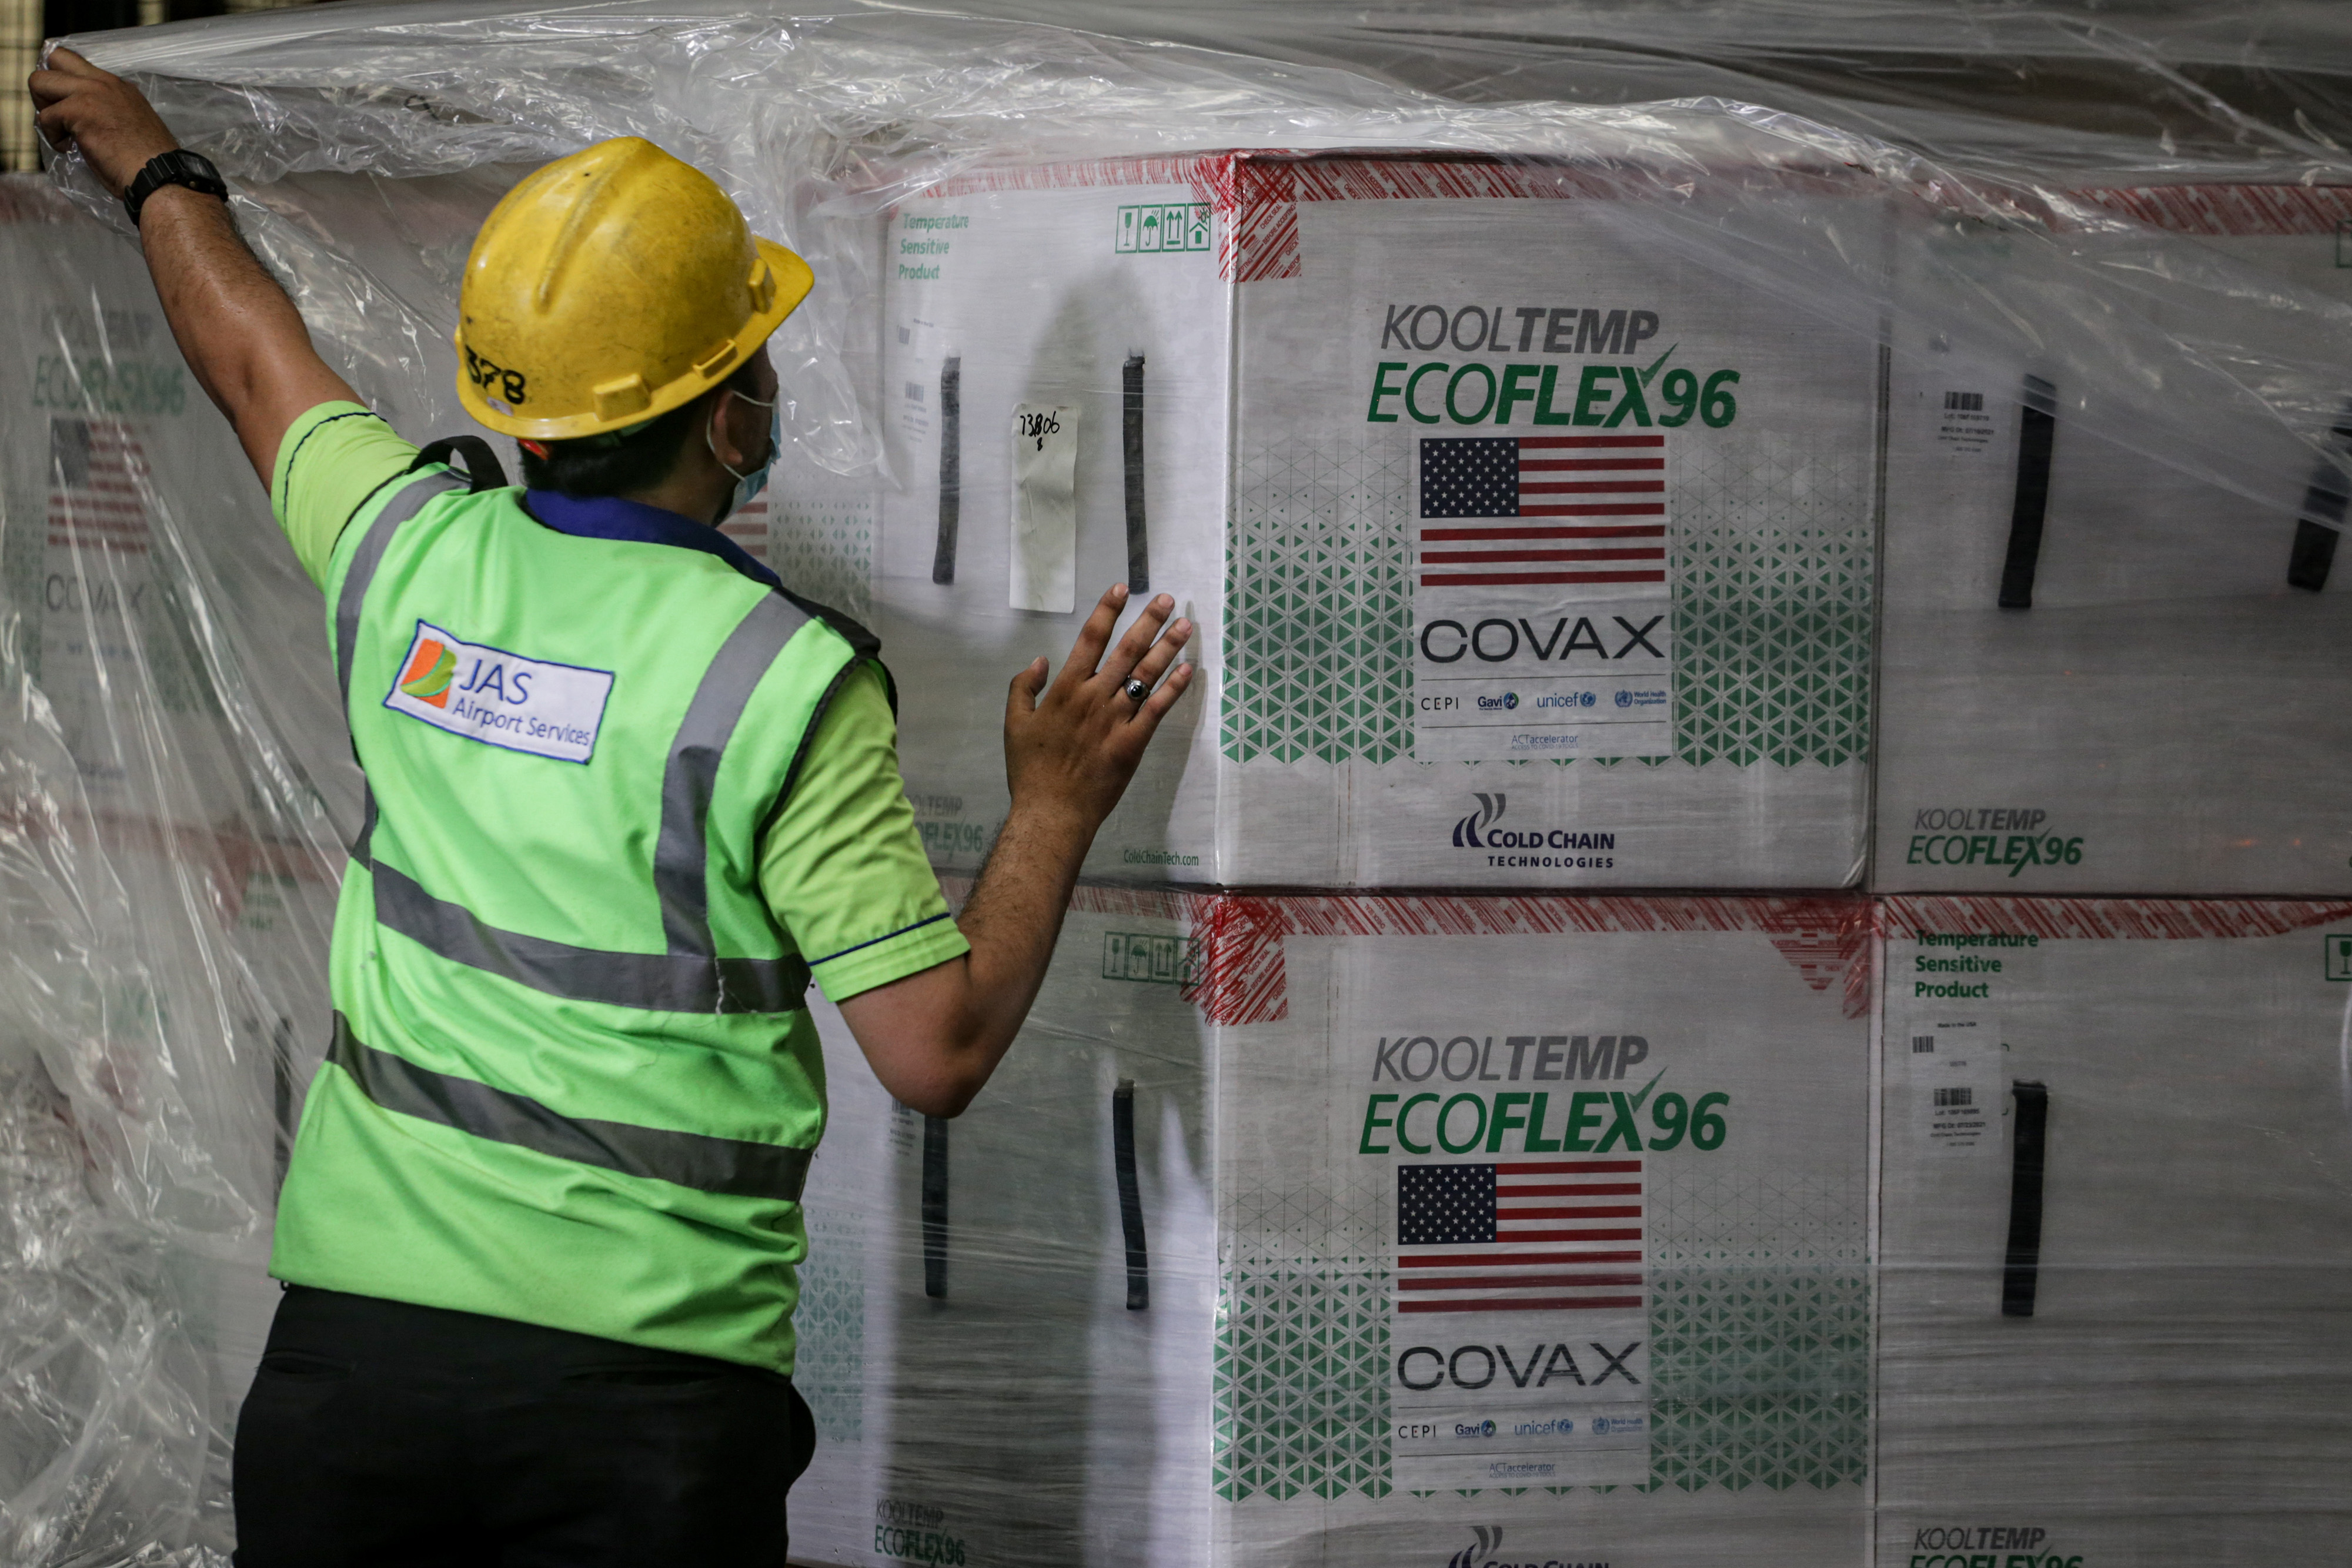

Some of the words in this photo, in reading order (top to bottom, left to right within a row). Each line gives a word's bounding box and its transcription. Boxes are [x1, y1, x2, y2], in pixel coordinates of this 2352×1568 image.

[903, 213, 969, 233] Temperature
[1259, 213, 1275, 229] CHECK
[1271, 203, 1283, 218] SEAL
[1262, 225, 1279, 245] BEFORE
[900, 238, 950, 255] Sensitive
[898, 263, 940, 280] Product
[1380, 304, 1660, 355] KOOLTEMP
[1366, 360, 1741, 429] ECOFLEX96
[1420, 615, 1666, 663] COVAX
[459, 659, 532, 705] JAS
[1421, 697, 1459, 710] CEPI
[1478, 696, 1502, 707] Gavi
[1536, 692, 1579, 708] unicef
[1633, 690, 1649, 700] World
[1650, 690, 1666, 700] Health
[1633, 698, 1666, 706] Organization
[453, 698, 523, 733] Airport
[526, 717, 592, 746] Services
[1914, 808, 2046, 831] KOOLTEMP
[1487, 829, 1544, 849] COLD
[1548, 830, 1615, 850] CHAIN
[1124, 849, 1199, 866] ColdChainTech.com
[1488, 855, 1613, 868] TECHNOLOGIES
[1906, 835, 2083, 877] ECOFLEX96
[1915, 930, 2039, 950] Temperature
[1915, 955, 2002, 973] Sensitive
[1915, 981, 1989, 998] Product
[1372, 1035, 1649, 1082] KOOLTEMP
[1358, 1091, 1730, 1155] ECOFLEX96
[1397, 1341, 1642, 1391] COVAX
[1398, 1425, 1436, 1439] CEPI
[1455, 1424, 1480, 1436] Gavi
[1515, 1419, 1556, 1436] unicef
[876, 1499, 944, 1529] KOOLTEMP
[874, 1524, 966, 1568] ECOFLEX96
[1913, 1527, 2046, 1550] KOOLTEMP
